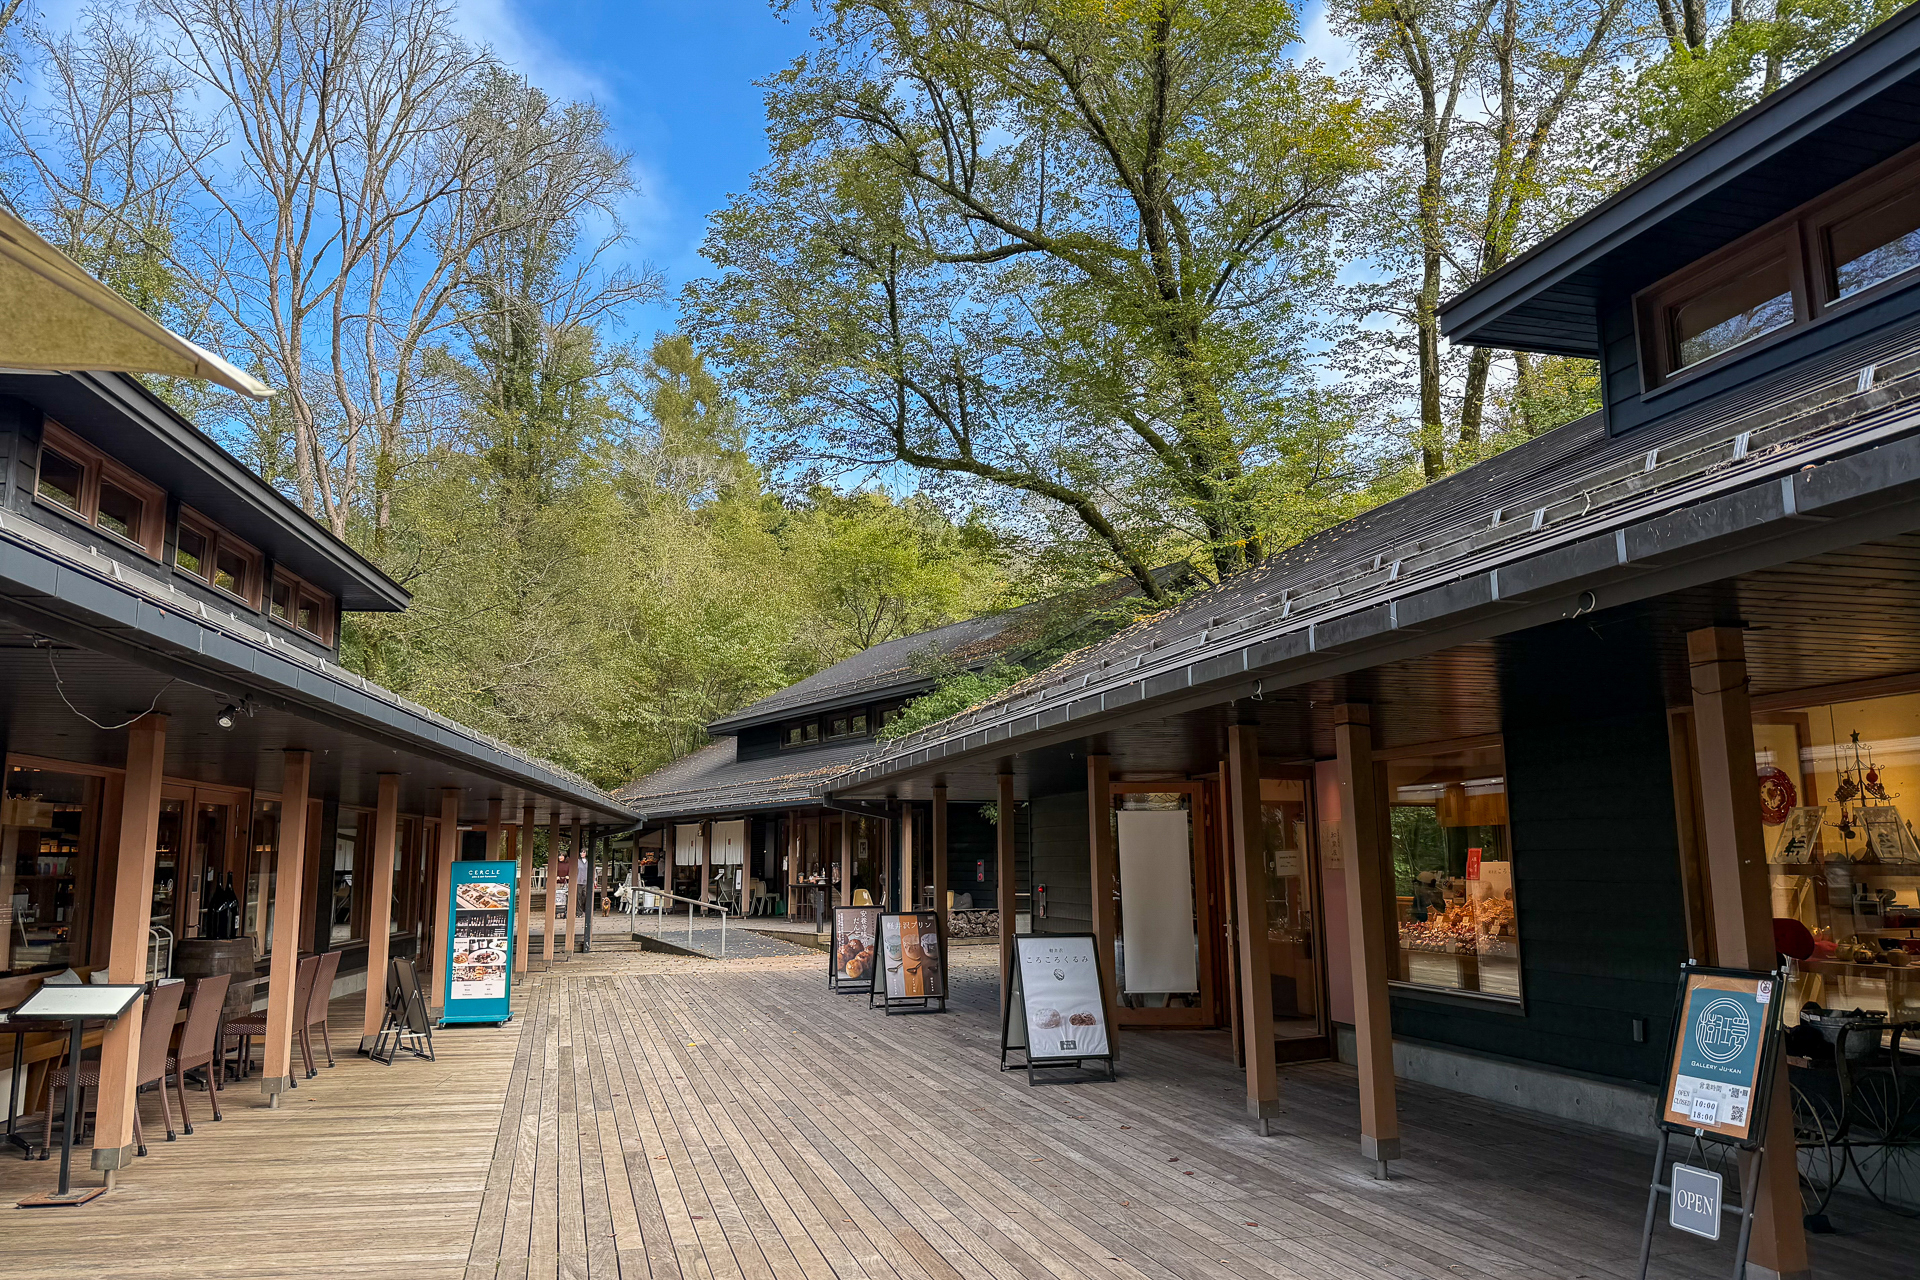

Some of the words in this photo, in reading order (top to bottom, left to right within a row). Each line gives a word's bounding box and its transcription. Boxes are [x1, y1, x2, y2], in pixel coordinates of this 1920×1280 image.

[853, 917, 861, 938] だんご
[887, 921, 931, 930] 軽井沢プリン
[1026, 955, 1089, 964] ころころくるみ
[1690, 1060, 1717, 1070] GALLERY
[1698, 1082, 1723, 1093] 営業時間
[1677, 1089, 1691, 1097] OPEN
[1673, 1097, 1691, 1107] CLOSED
[1694, 1099, 1716, 1110] 10:00
[1692, 1111, 1714, 1122] 18:00
[1677, 1189, 1714, 1217] OPEN
